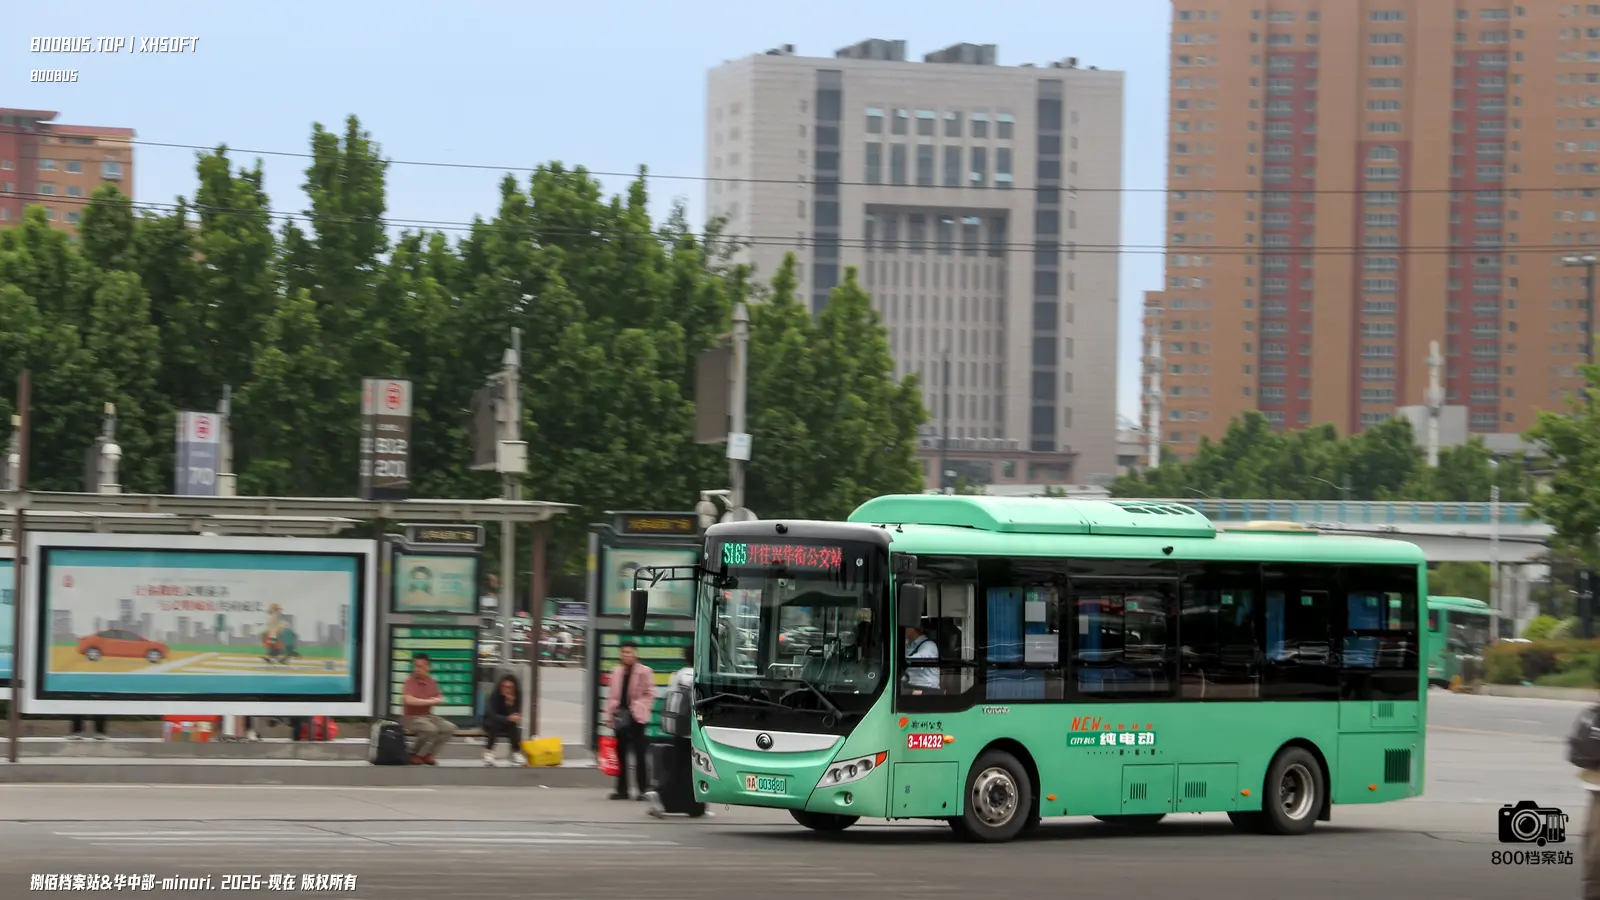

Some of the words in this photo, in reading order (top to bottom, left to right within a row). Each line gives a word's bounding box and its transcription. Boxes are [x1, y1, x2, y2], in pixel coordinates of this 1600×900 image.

[724, 543, 747, 564] S165
[1071, 716, 1102, 731] NEW
[908, 735, 943, 748] 3-14232
[1070, 737, 1084, 745] CITY
[1084, 736, 1096, 745] BUS
[1099, 732, 1154, 746] 纯电动
